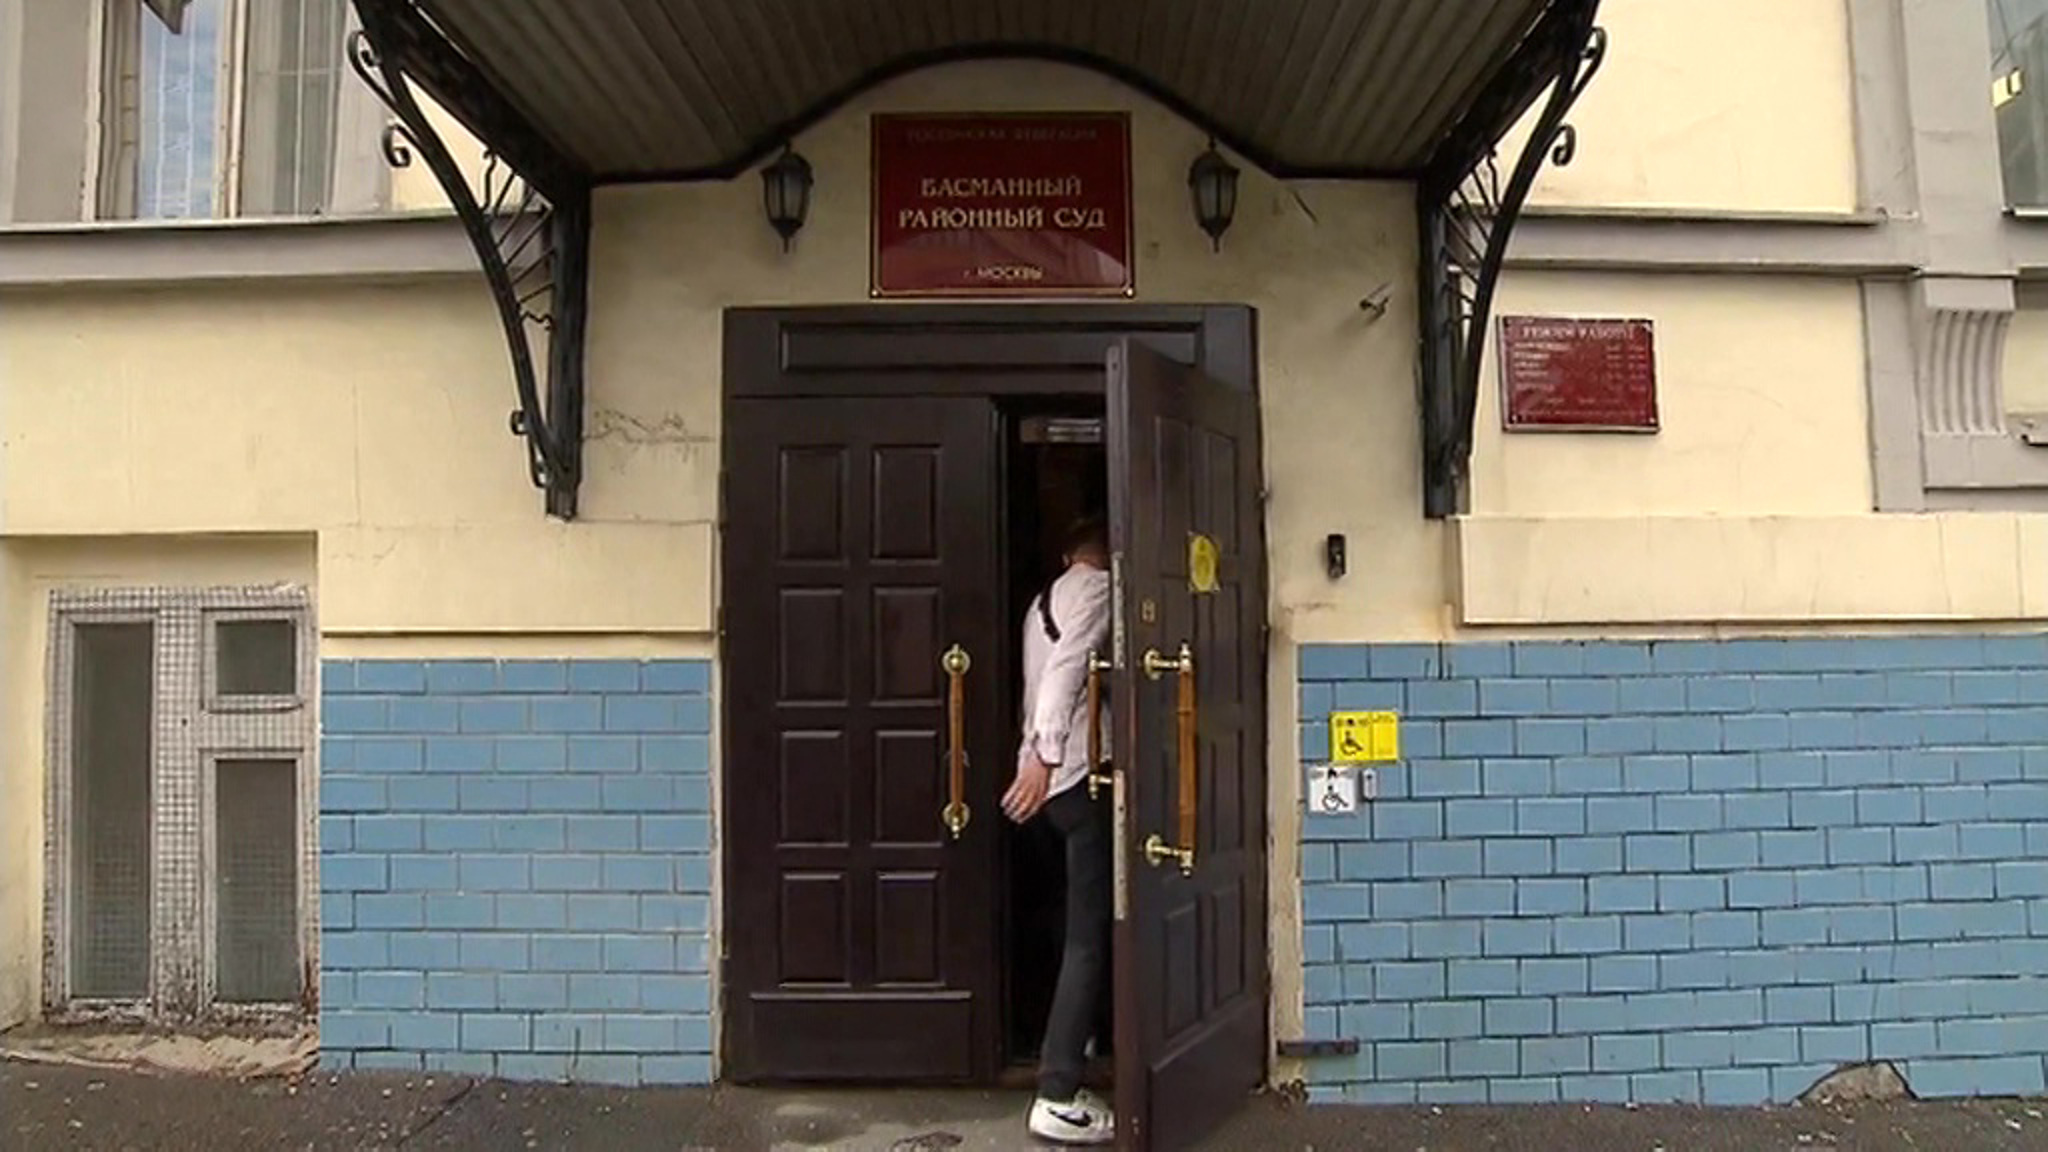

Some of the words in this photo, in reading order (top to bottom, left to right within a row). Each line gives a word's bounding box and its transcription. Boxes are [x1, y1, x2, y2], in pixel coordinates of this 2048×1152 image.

[921, 175, 1082, 197] БАСМАННЫЙ
[899, 205, 1044, 229] РАЙОННЫЙ
[1053, 207, 1106, 229] СУД
